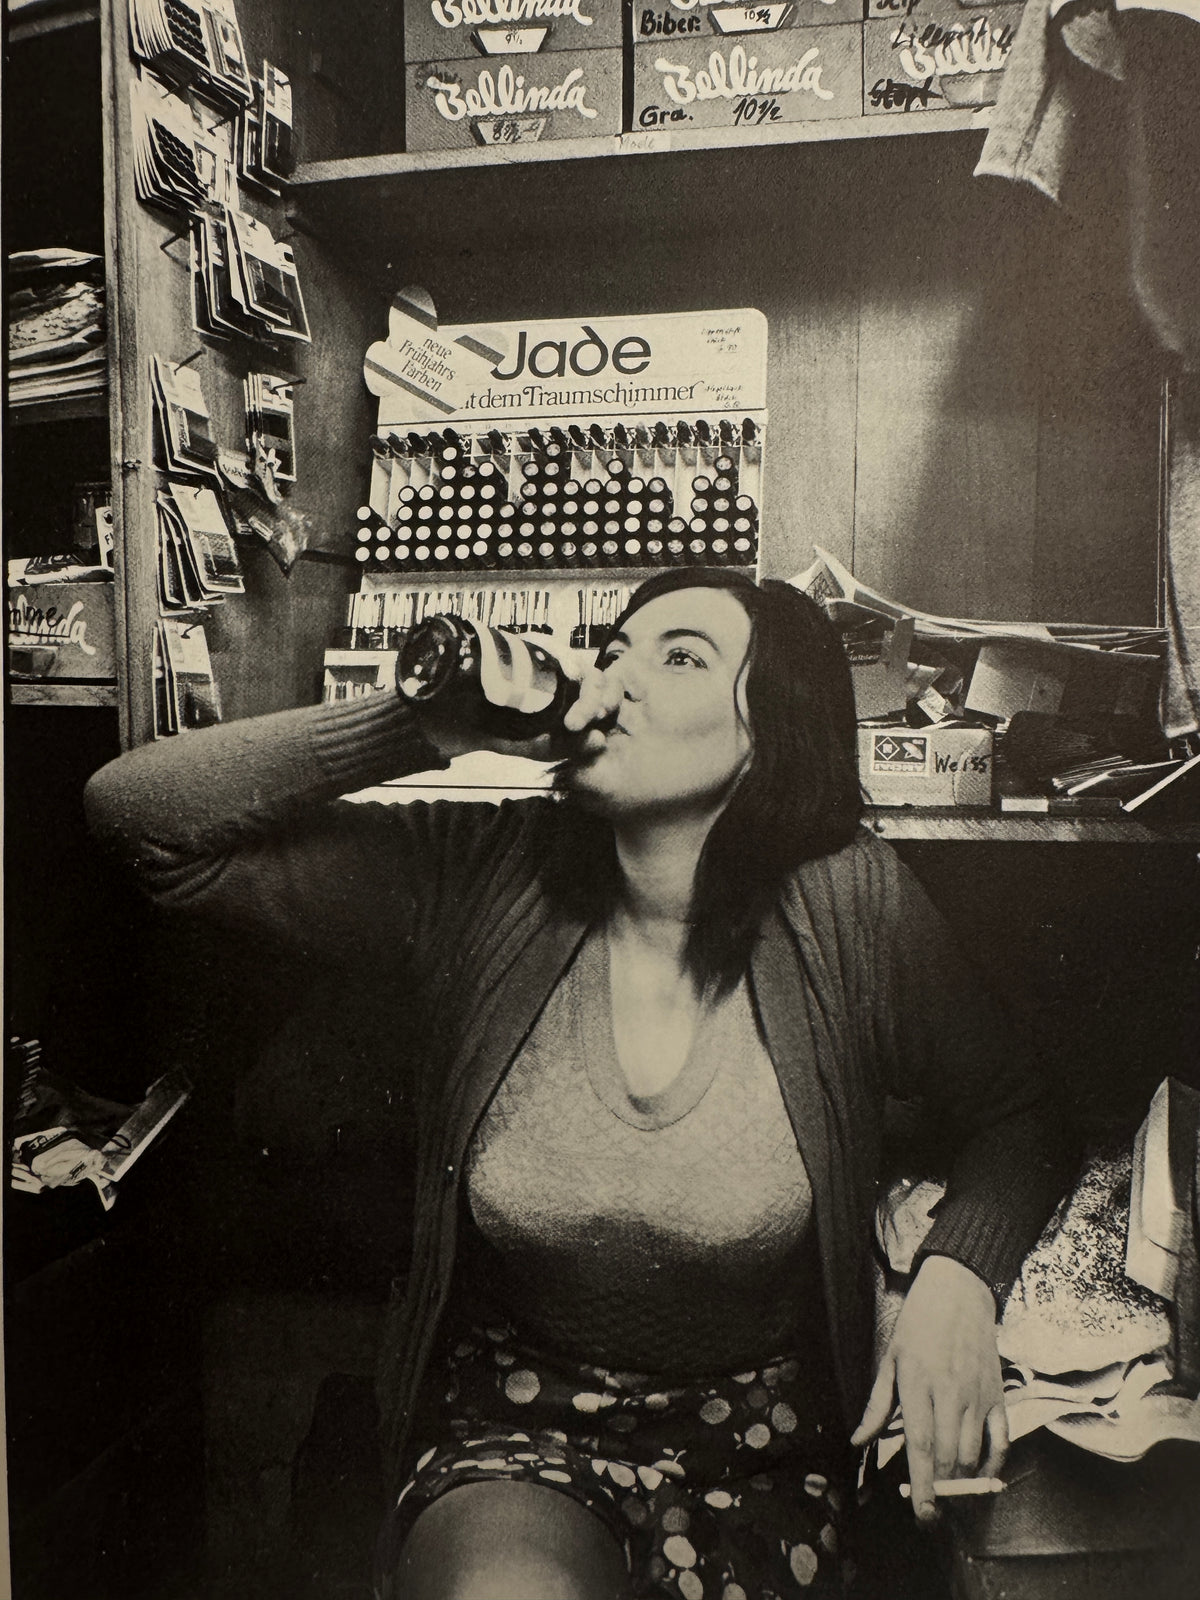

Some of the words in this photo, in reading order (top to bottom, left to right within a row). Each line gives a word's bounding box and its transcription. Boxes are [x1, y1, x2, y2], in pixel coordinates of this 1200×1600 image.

[427, 64, 598, 121] Bellinda
[655, 45, 834, 105] Bellinda
[401, 360, 442, 392] Farben
[490, 325, 651, 381] Jade
[478, 388, 522, 408] dem
[522, 381, 704, 408] Traumschimmer
